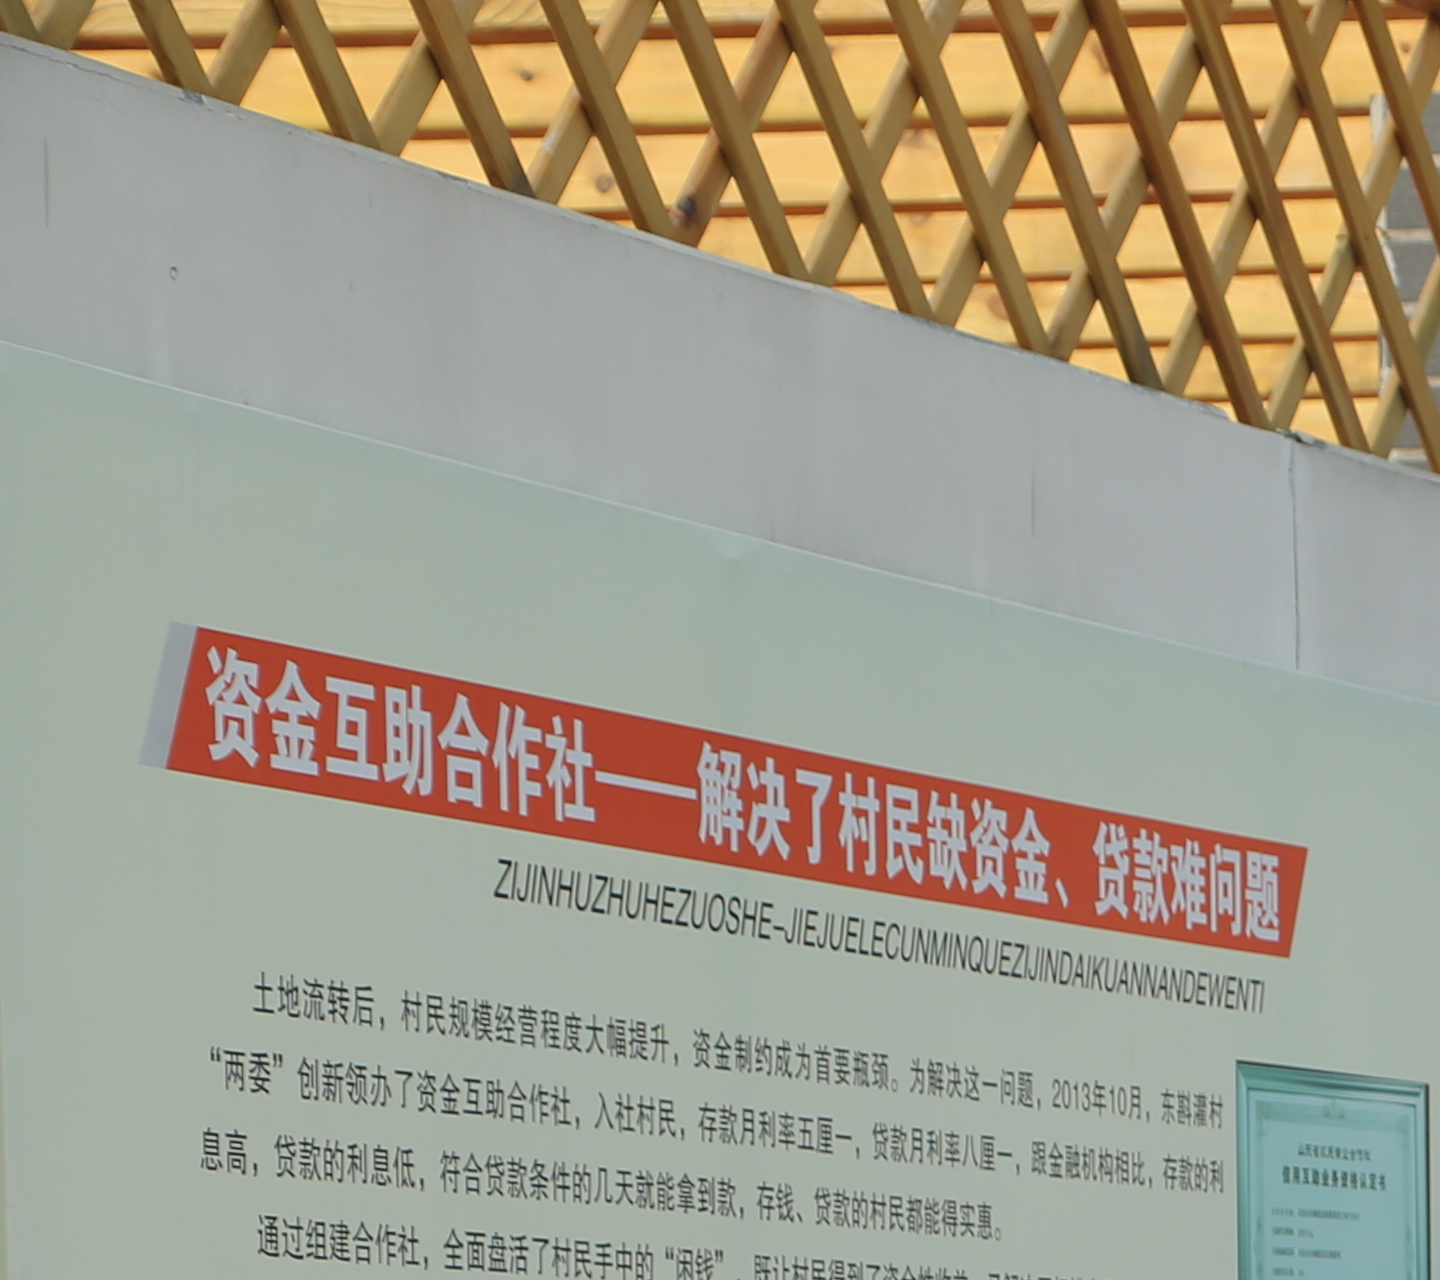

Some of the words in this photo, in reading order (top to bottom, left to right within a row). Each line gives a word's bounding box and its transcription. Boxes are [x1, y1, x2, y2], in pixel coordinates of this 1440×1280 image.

[204, 646, 1282, 943] 资金互助合作社——解决了村民缺资金、贷款难问题
